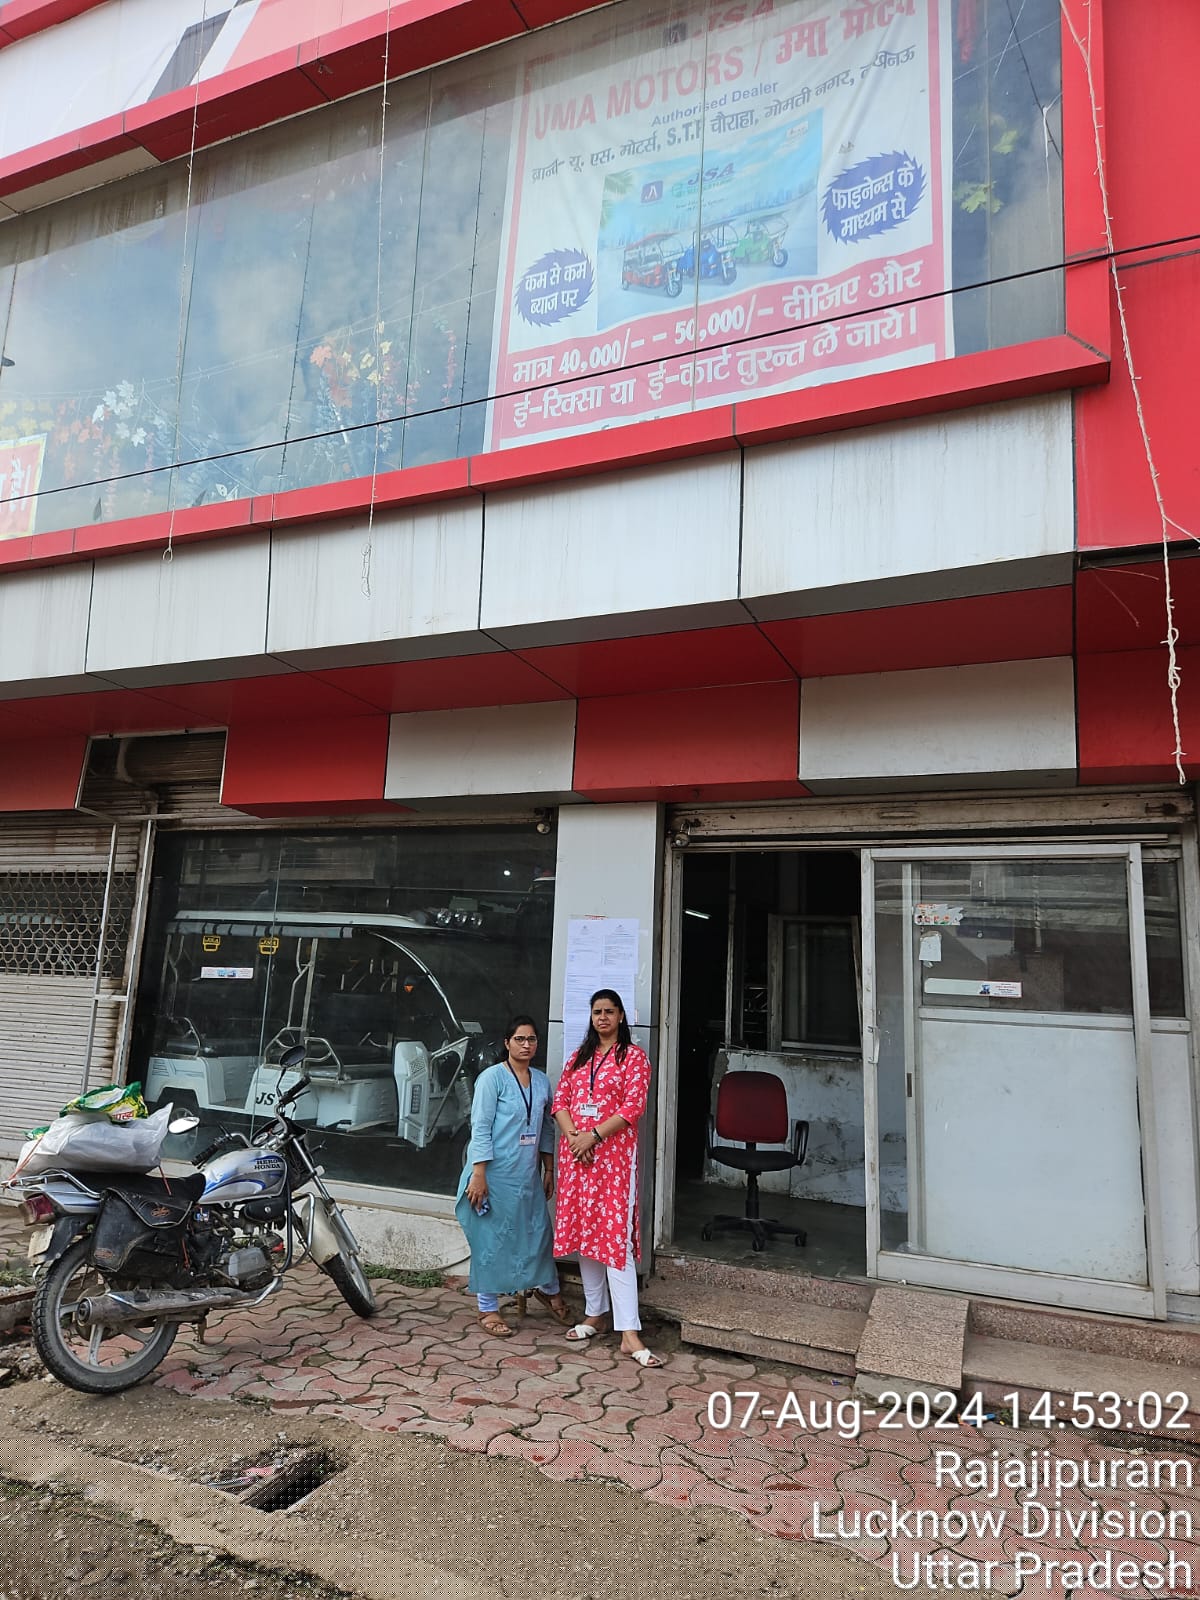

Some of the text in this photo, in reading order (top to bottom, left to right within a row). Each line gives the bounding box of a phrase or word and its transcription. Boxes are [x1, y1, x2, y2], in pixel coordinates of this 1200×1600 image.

[534, 93, 596, 140] UMA
[606, 46, 744, 121] MOTORS
[773, 16, 831, 65] उमा
[651, 81, 779, 128] Authorised Dealer
[764, 86, 812, 118] गोमती
[831, 160, 916, 211] फाइनेन्स के
[840, 191, 907, 238] माध्यम से
[525, 260, 587, 292] कम से कम
[513, 355, 555, 384] मात्र
[558, 327, 645, 376] 40,000/-
[782, 276, 861, 321] दीजिए
[867, 260, 924, 298] और
[530, 288, 579, 315] ब्याज पर
[610, 379, 637, 406] या
[736, 341, 807, 386] तुरन्त
[812, 323, 841, 357] ले
[255, 1092, 276, 1106] JS
